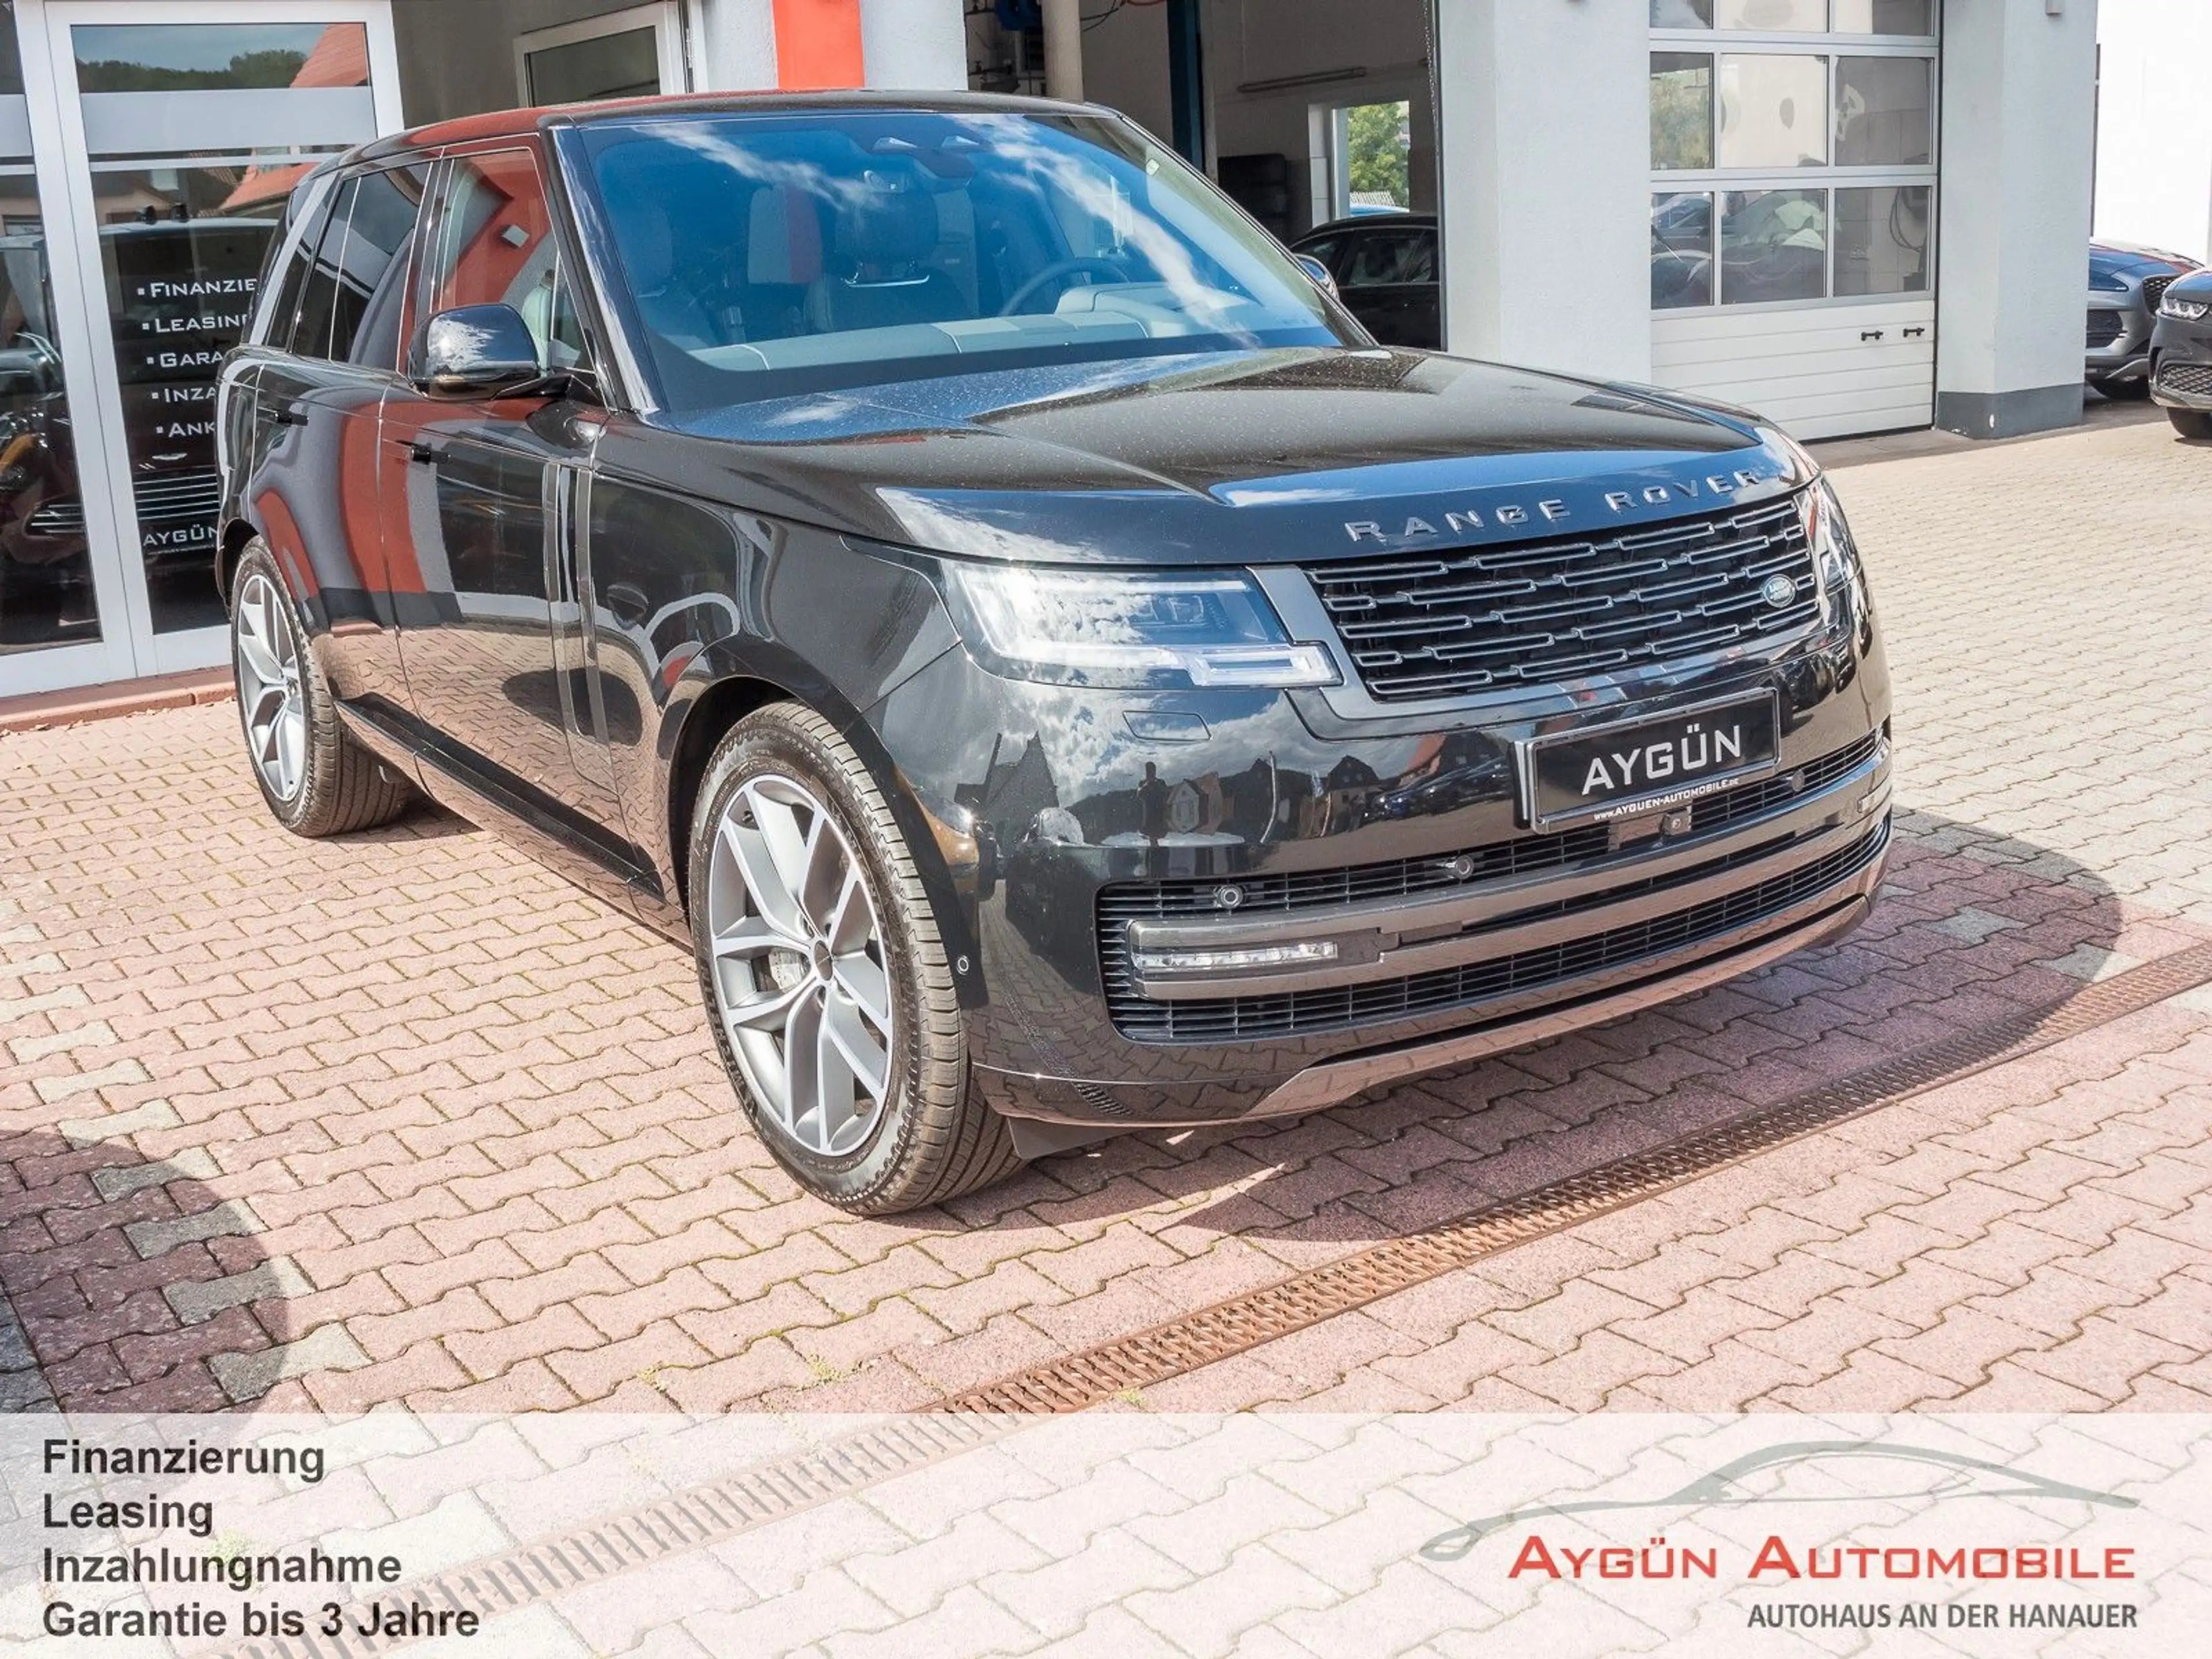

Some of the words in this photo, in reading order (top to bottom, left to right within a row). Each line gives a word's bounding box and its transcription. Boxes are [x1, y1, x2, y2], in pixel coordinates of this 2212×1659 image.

[1344, 498, 1571, 542] RANGE
[1605, 469, 1760, 511] ROVER
[1581, 724, 1740, 796] AYGÜN
